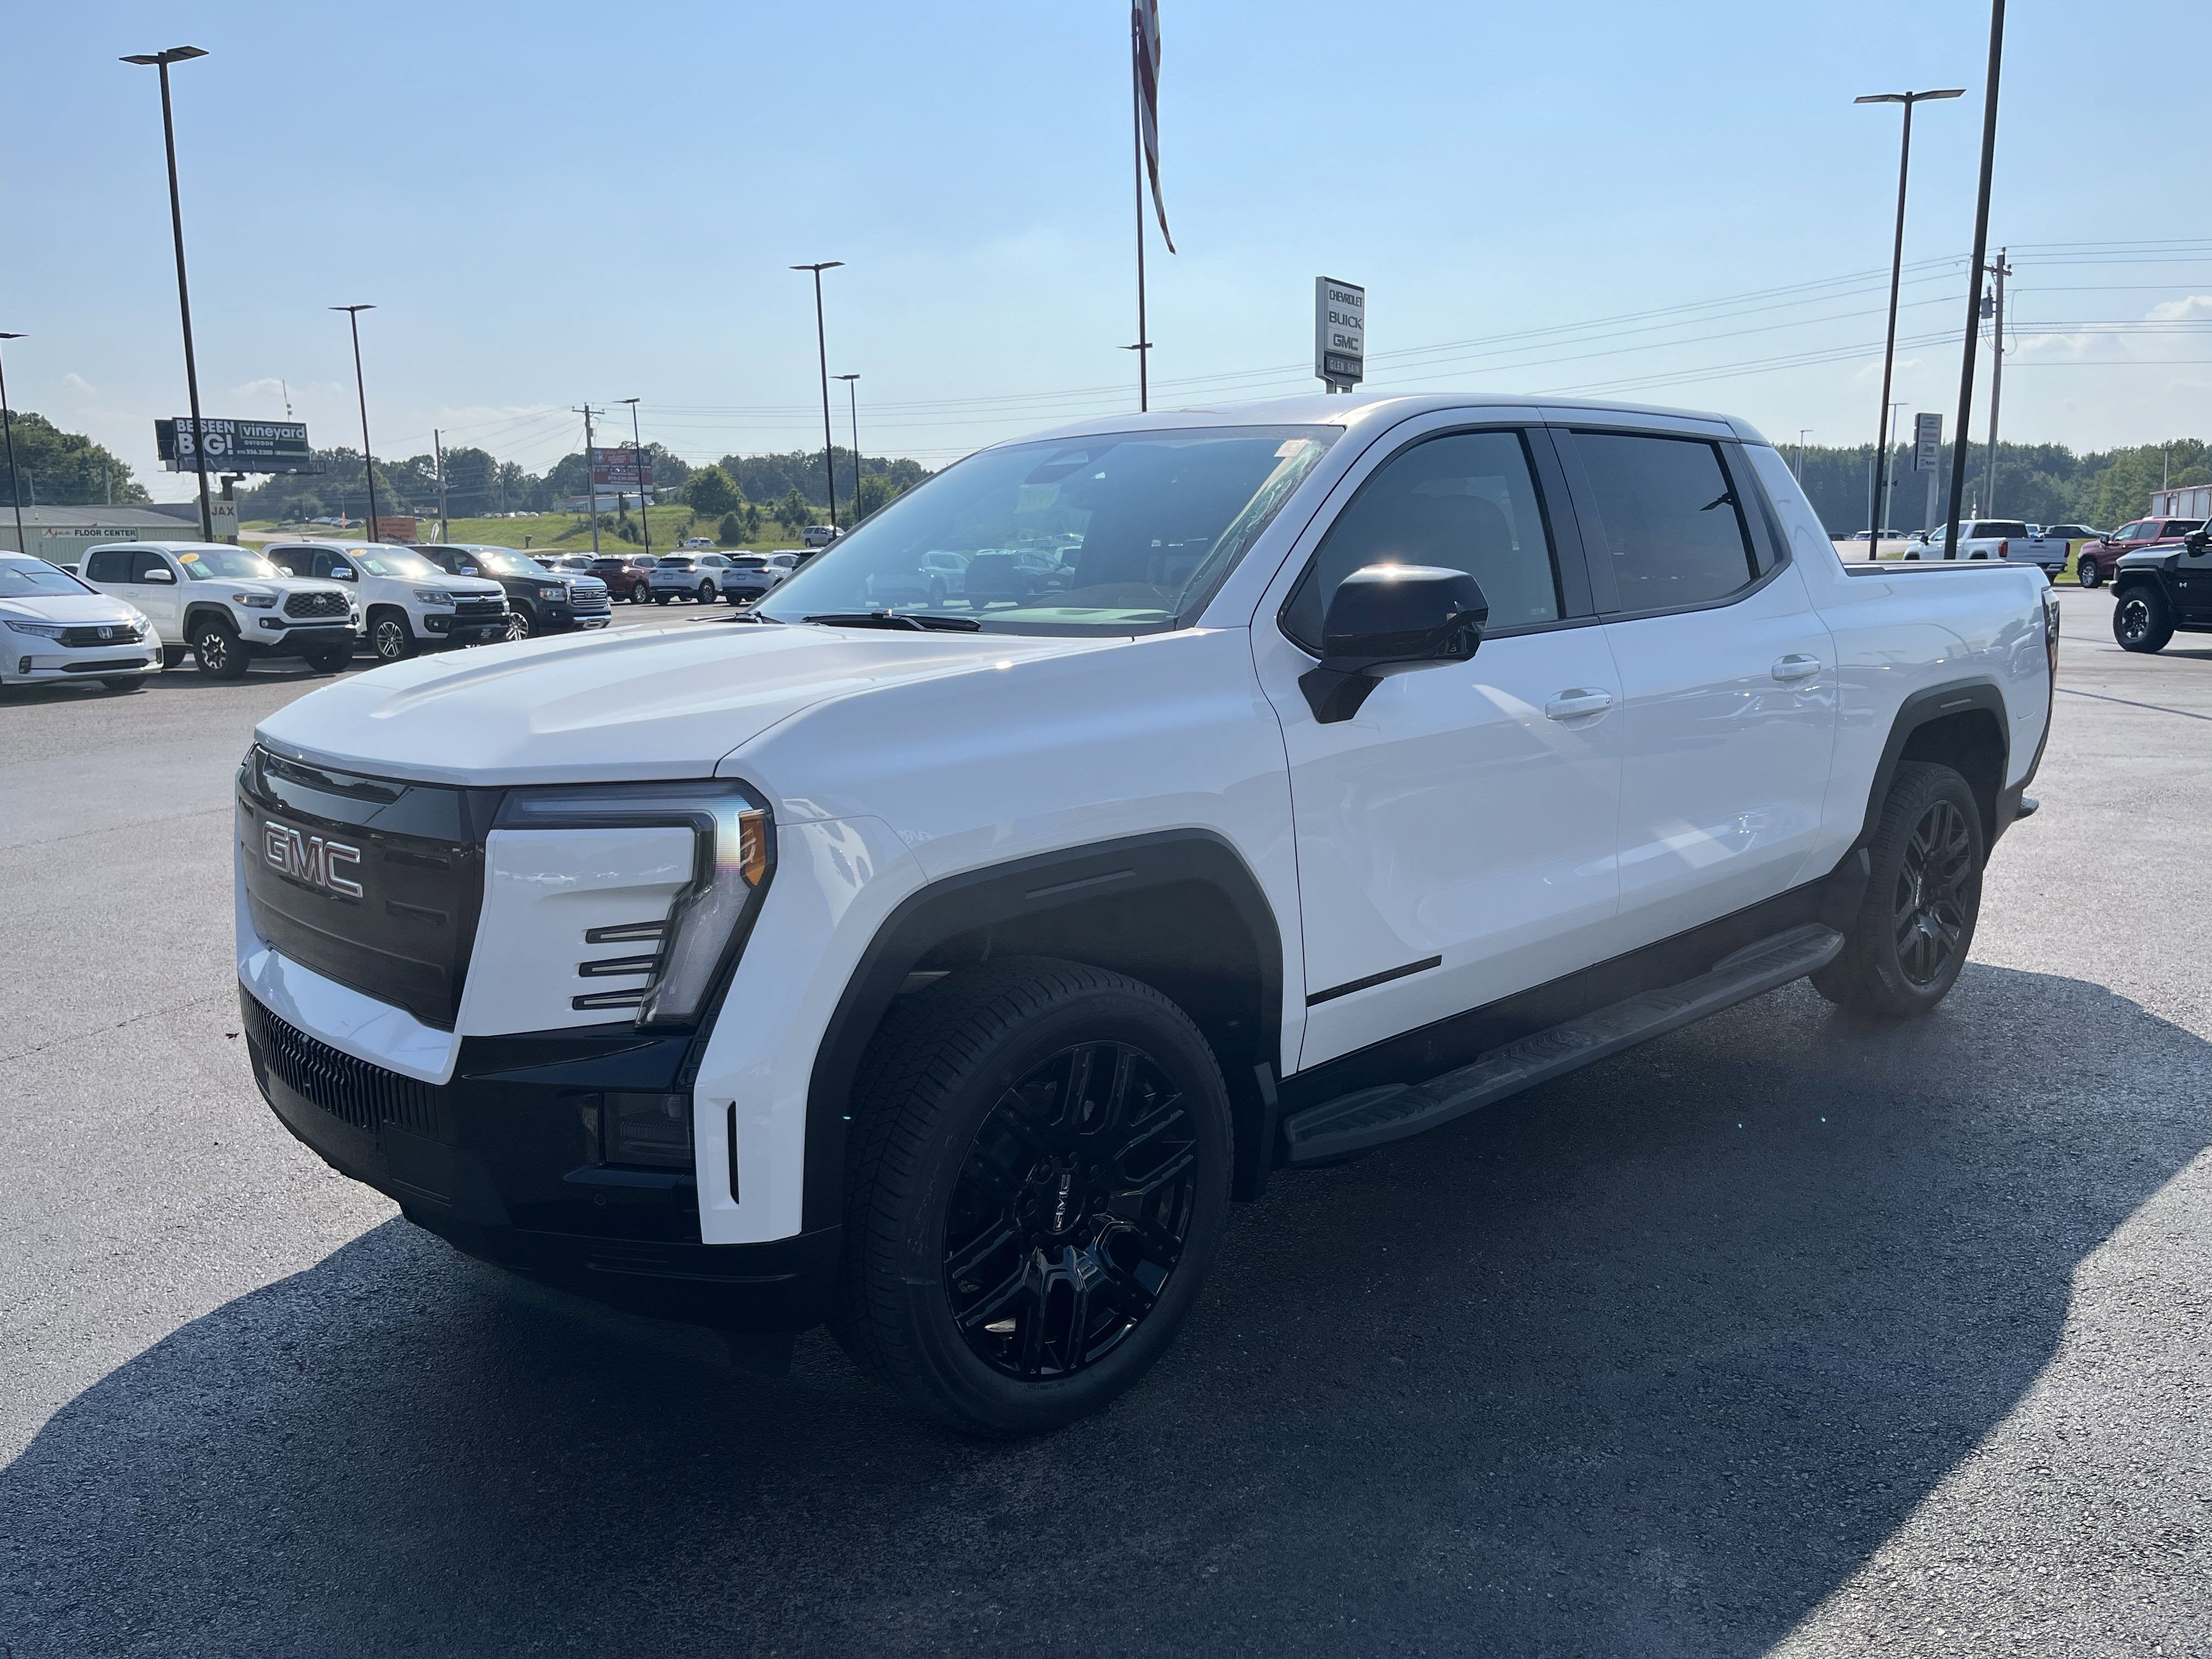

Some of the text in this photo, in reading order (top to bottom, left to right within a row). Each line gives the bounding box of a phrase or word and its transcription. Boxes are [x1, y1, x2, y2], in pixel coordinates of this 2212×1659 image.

[1329, 289, 1363, 307] CHEVROLET
[1329, 311, 1363, 330] BUICK
[1333, 333, 1358, 351] GMC
[1330, 359, 1359, 374] GLEN SAIN
[176, 419, 235, 434] BE SEEN
[242, 423, 306, 441] vineyard
[178, 433, 233, 455] BG!
[211, 506, 235, 516] JAX
[262, 820, 364, 899] GMC
[1053, 1173, 1071, 1231] GMC
